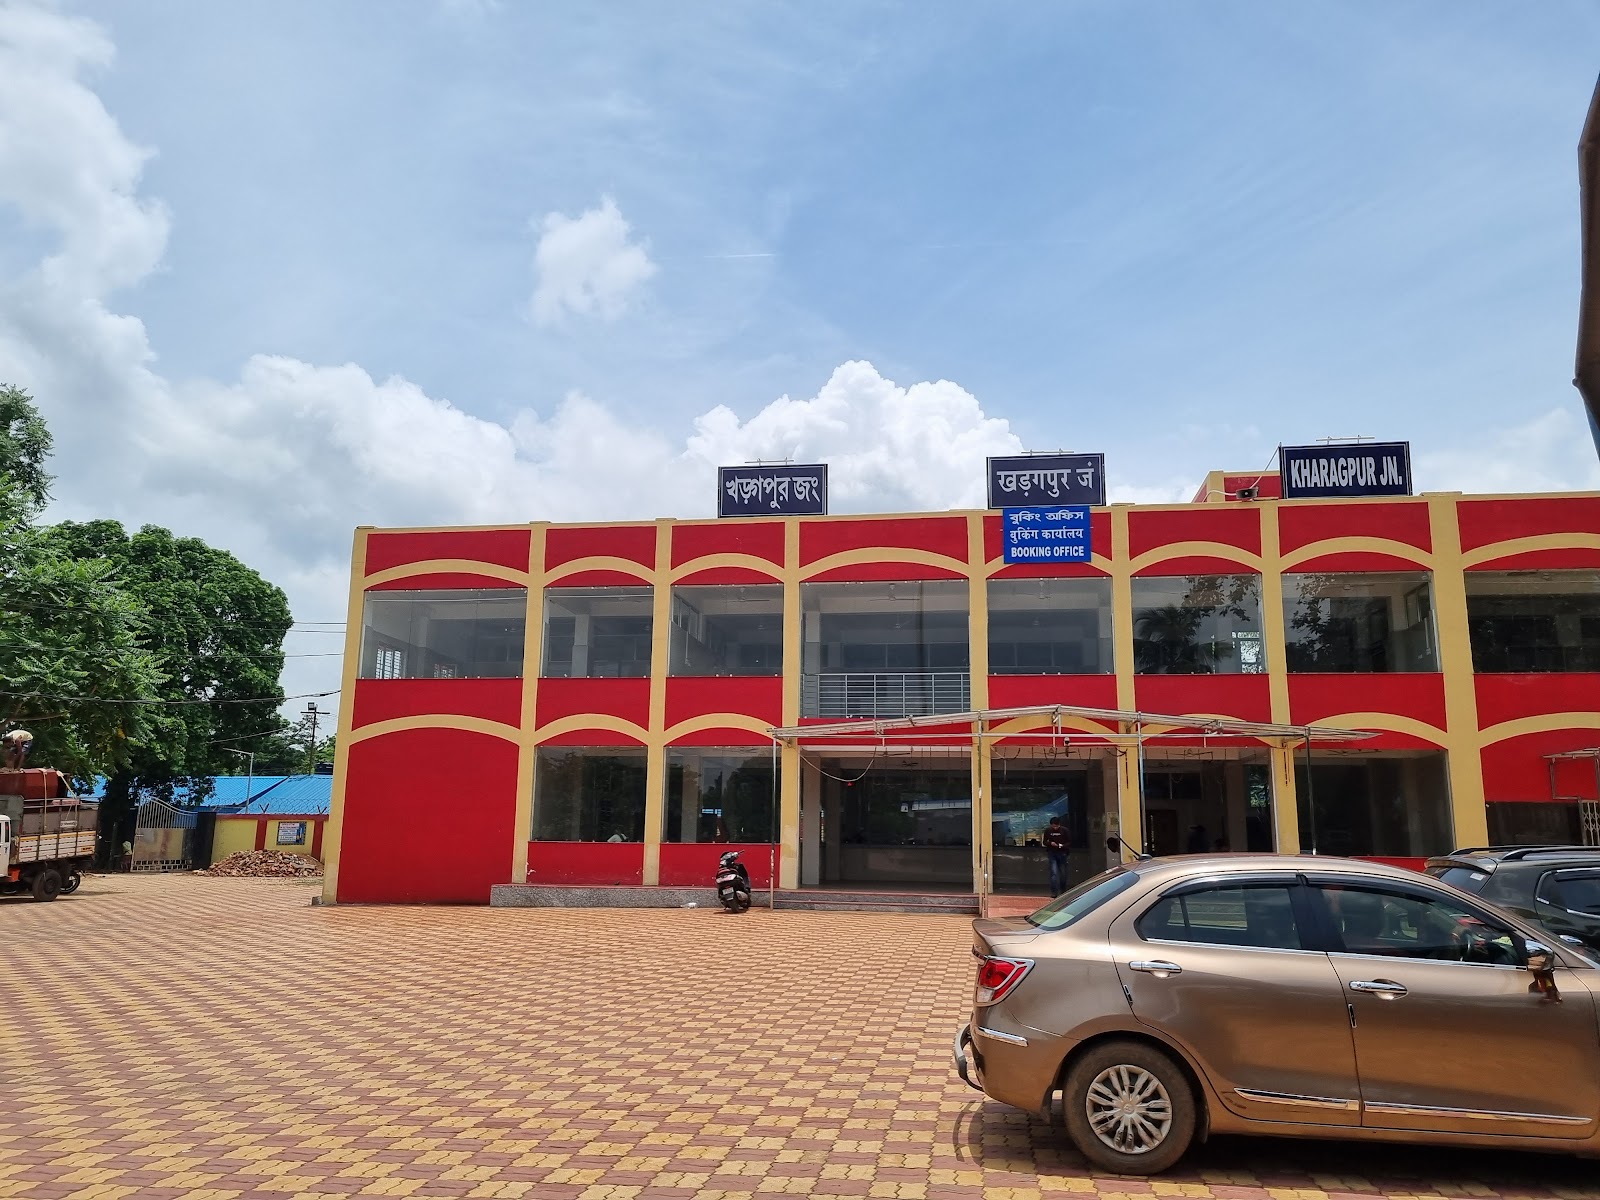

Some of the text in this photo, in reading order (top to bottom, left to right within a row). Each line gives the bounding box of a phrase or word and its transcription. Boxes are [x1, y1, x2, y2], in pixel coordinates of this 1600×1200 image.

[996, 461, 1095, 498] खड़गपुर जं
[1290, 455, 1403, 488] KHARAGPUR JN.
[791, 476, 821, 503] জং
[1008, 509, 1084, 525] বুকিং অফিস
[1041, 525, 1084, 539] कार्यालय
[1011, 545, 1085, 558] BOOKING OFFICE
